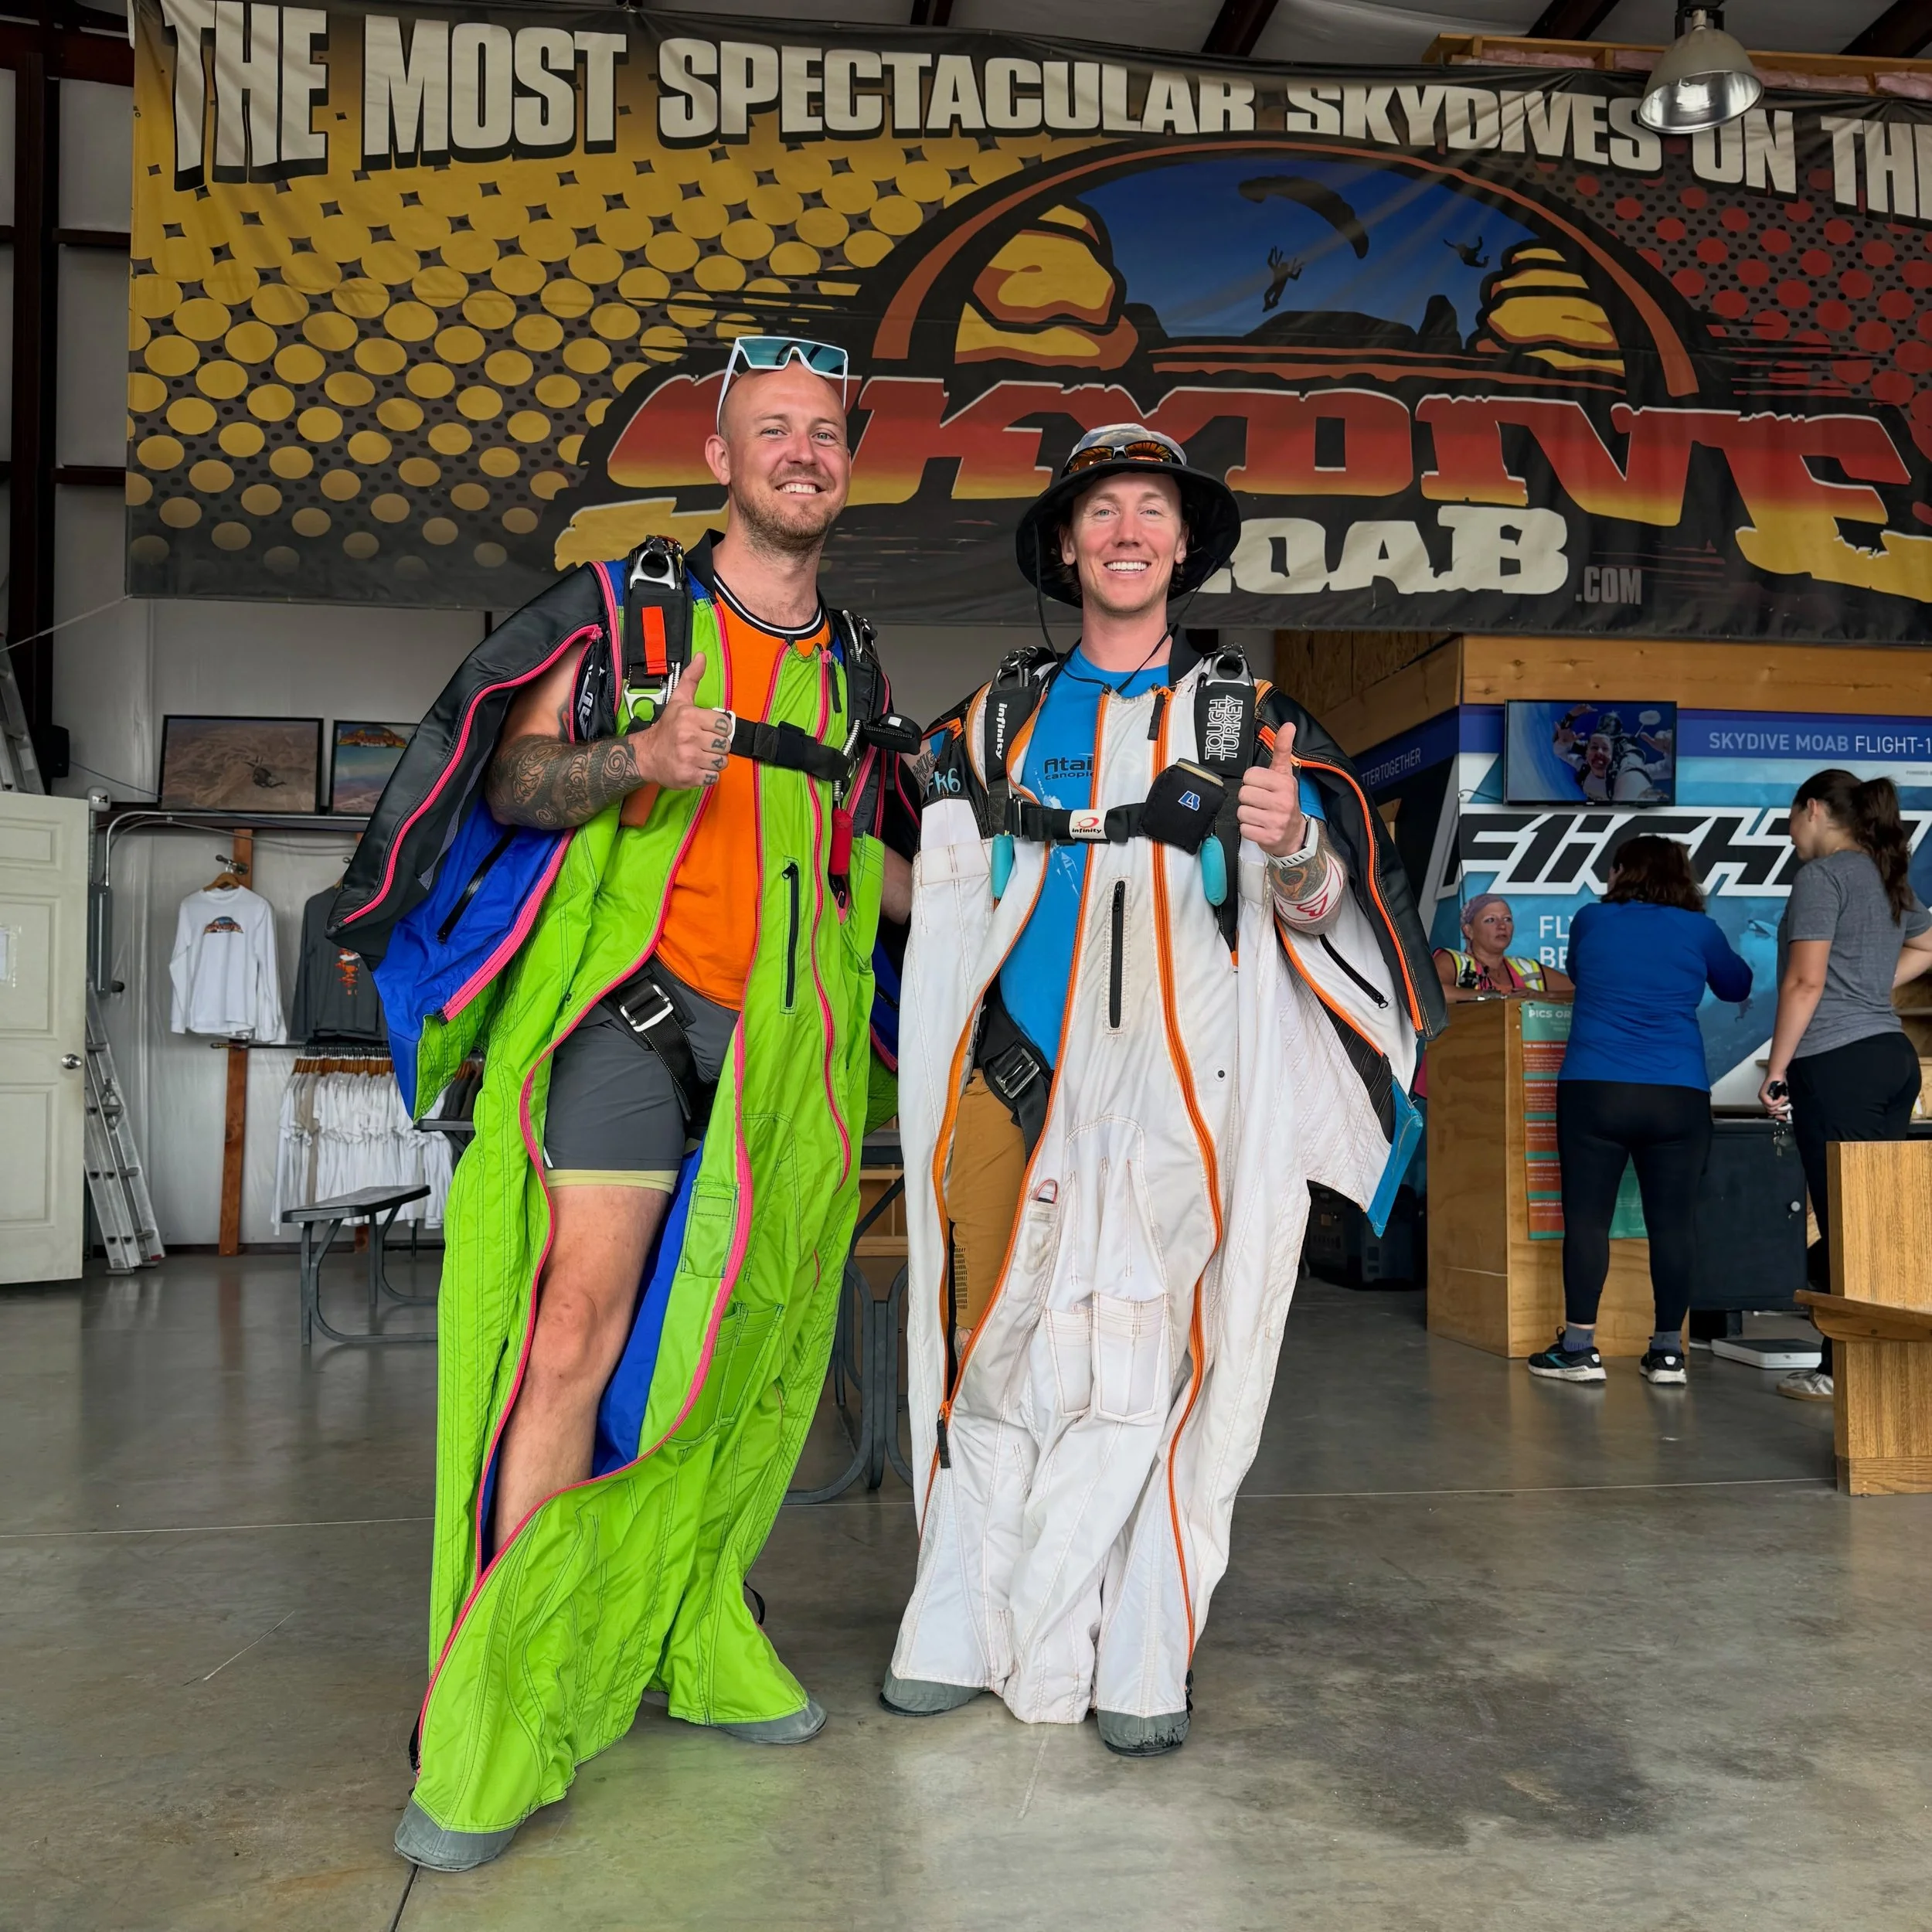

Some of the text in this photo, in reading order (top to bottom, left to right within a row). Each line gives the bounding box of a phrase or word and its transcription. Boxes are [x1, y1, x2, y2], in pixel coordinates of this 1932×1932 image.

[162, 0, 329, 179] THE
[363, 14, 628, 161] MOST
[658, 37, 1256, 144] SPECTACULAR
[1285, 82, 1662, 172] SKYDIVES
[1692, 108, 1798, 195] ON
[1190, 505, 1642, 605] OAB .COM
[1204, 699, 1227, 760] TOUGH
[1220, 694, 1244, 761] TURKEY
[1709, 732, 1931, 755] SKYDIVE MOAB FLIGHT-1
[1539, 915, 1574, 940] FL
[1528, 1009, 1553, 1019] PICS
